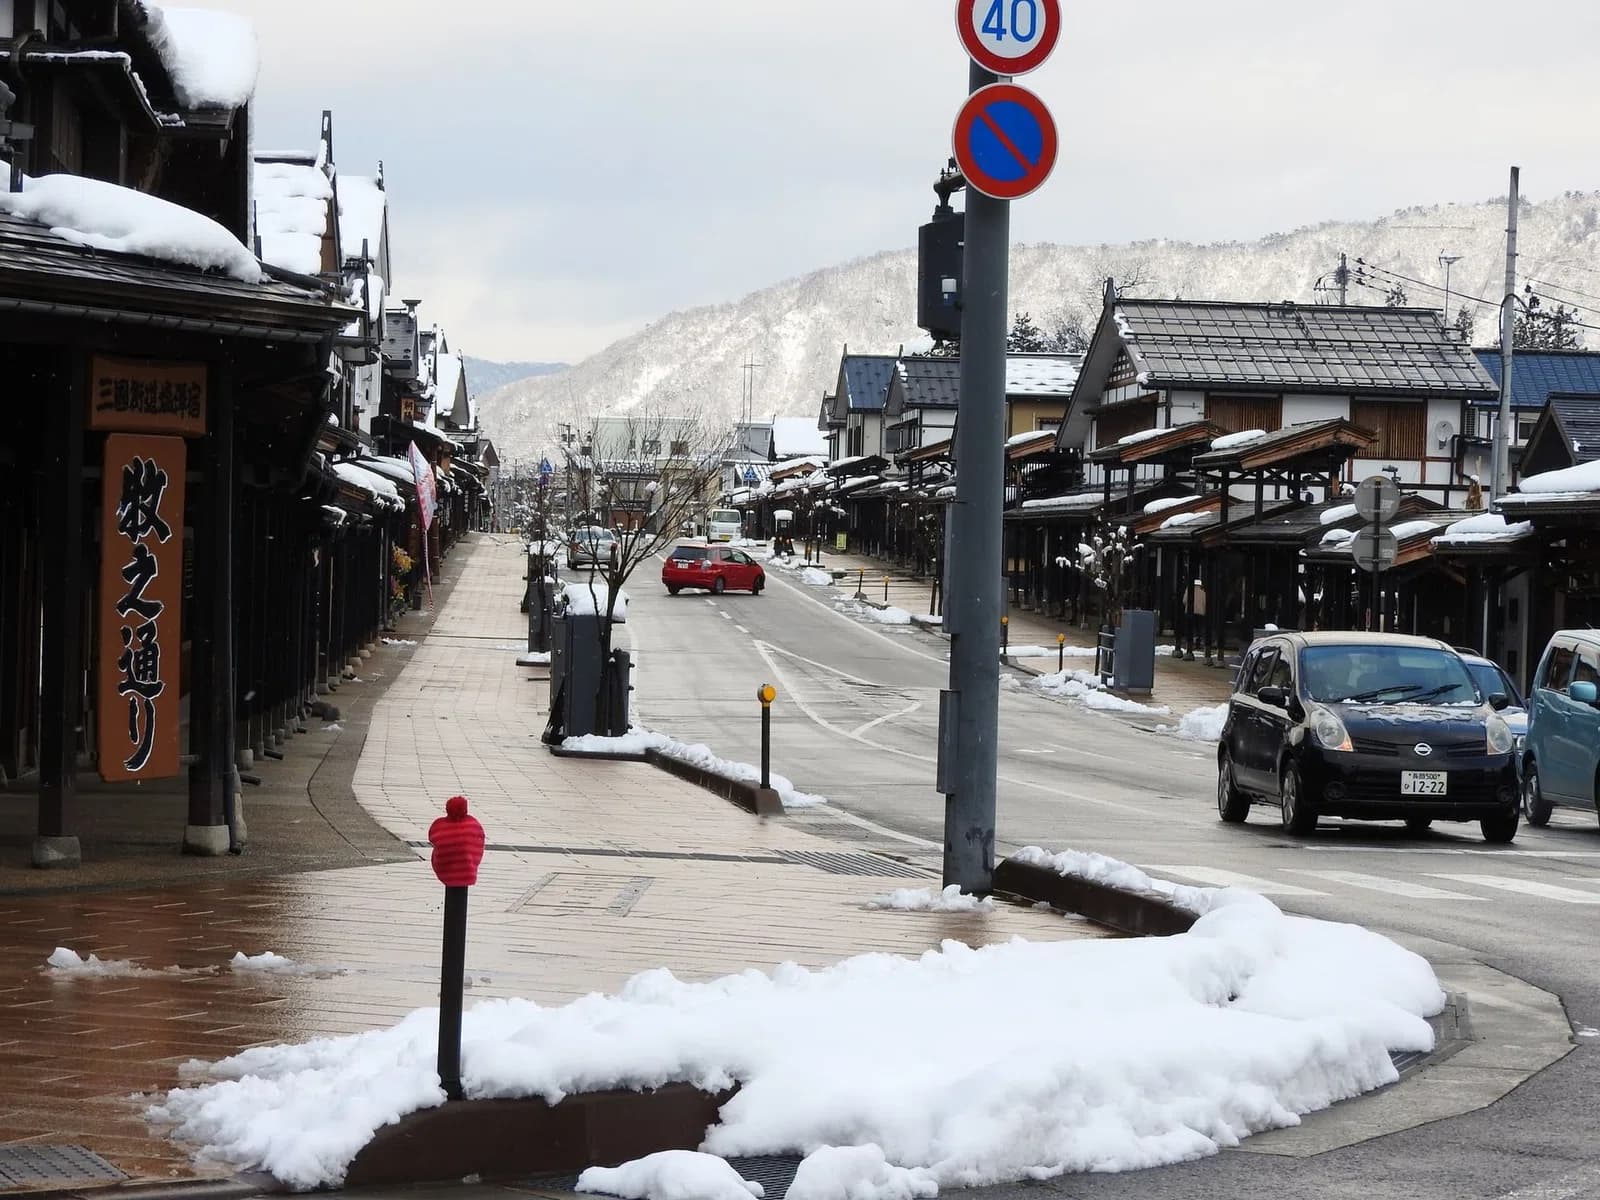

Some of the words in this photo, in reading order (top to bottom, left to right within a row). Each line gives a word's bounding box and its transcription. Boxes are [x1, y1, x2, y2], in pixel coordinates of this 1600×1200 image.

[981, 0, 1037, 43] 40
[116, 456, 172, 772] 牧之通り
[1413, 781, 1445, 793] 12-22
